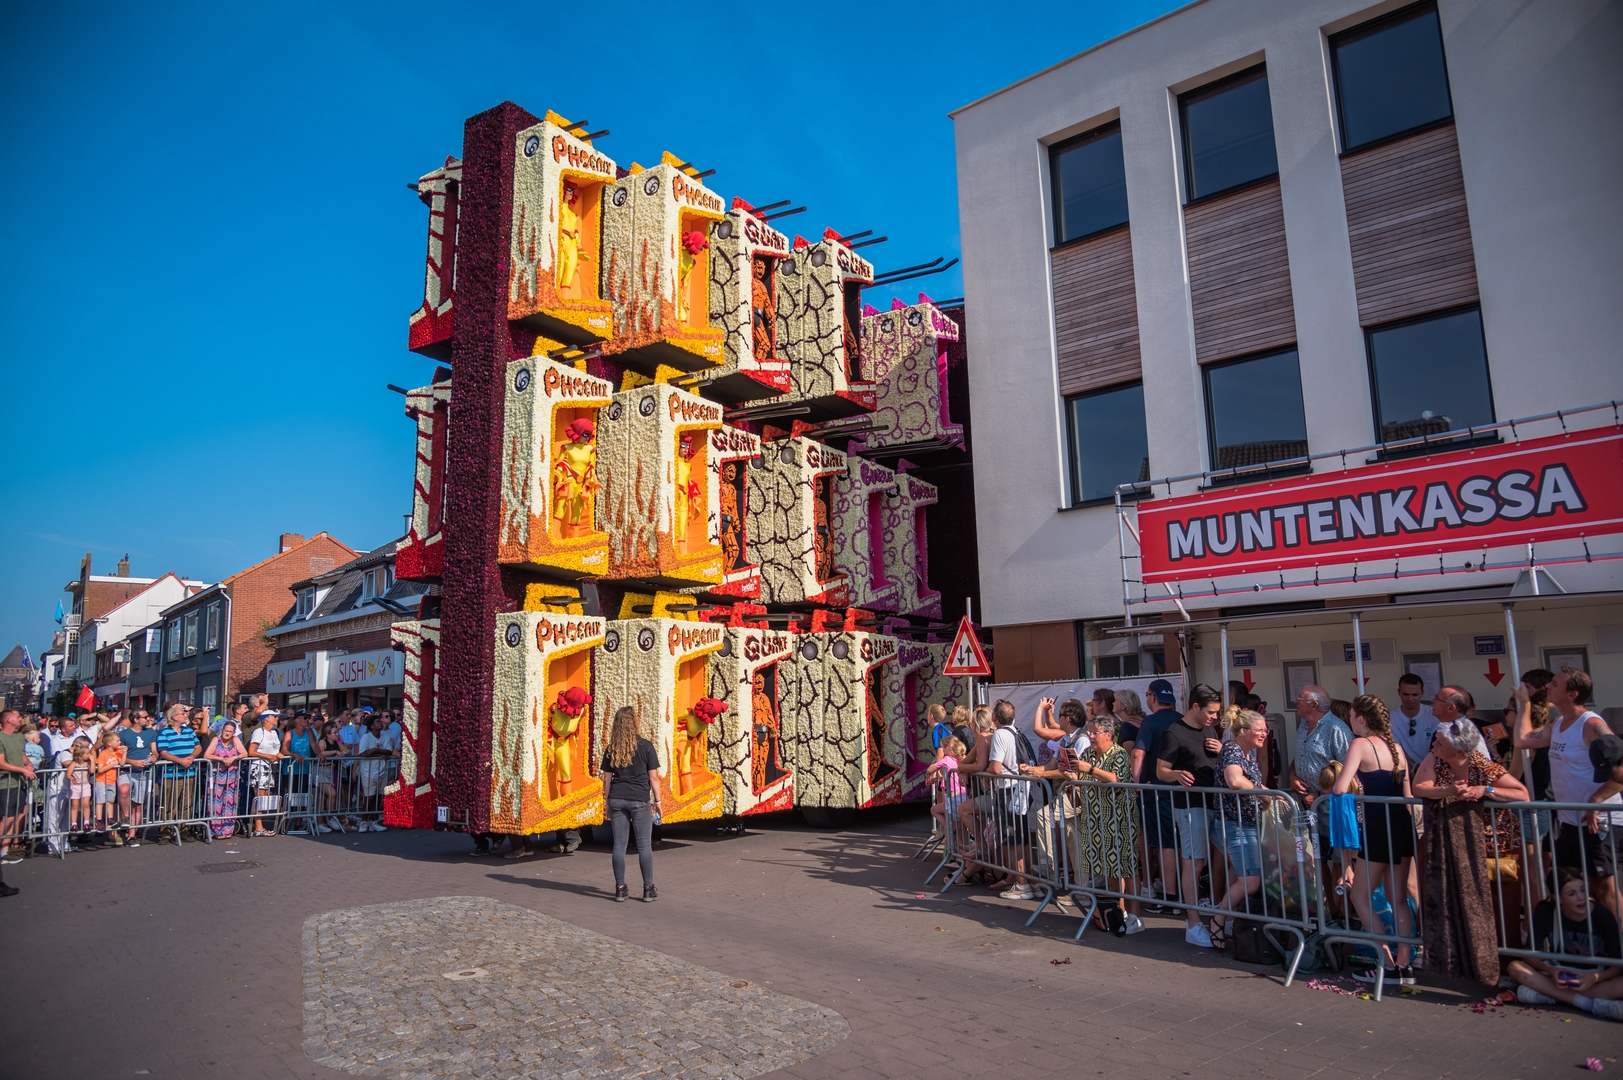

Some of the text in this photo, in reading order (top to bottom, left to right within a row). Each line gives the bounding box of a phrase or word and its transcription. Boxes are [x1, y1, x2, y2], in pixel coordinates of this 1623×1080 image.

[1167, 465, 1586, 560] MUNTENKASSA
[1477, 644, 1497, 652] PIN
[339, 660, 367, 682] SUSHI
[439, 809, 446, 817] 11
